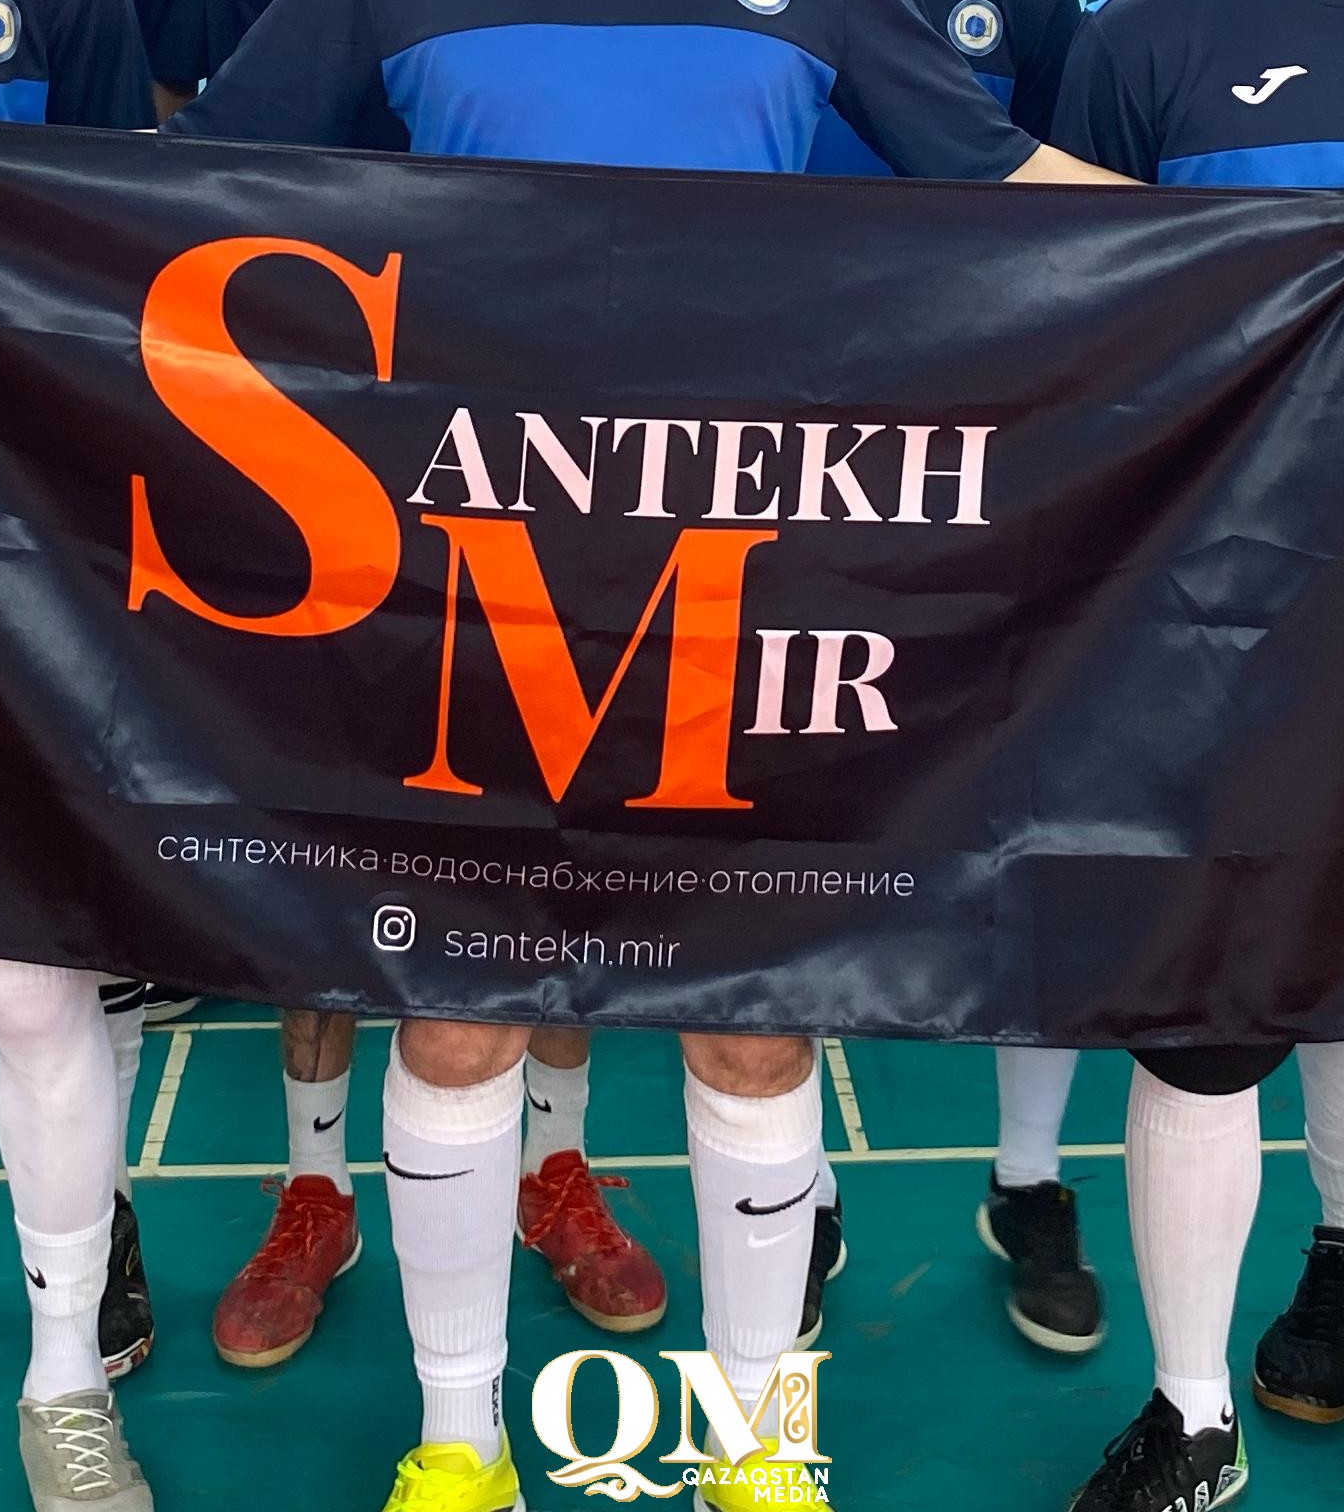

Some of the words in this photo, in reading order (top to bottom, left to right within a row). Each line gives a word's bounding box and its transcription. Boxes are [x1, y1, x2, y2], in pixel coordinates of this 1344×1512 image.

[128, 237, 997, 637] SANTEKH
[403, 513, 898, 809] MIR
[444, 928, 681, 969] santekh.mir
[708, 869, 916, 897] отопление
